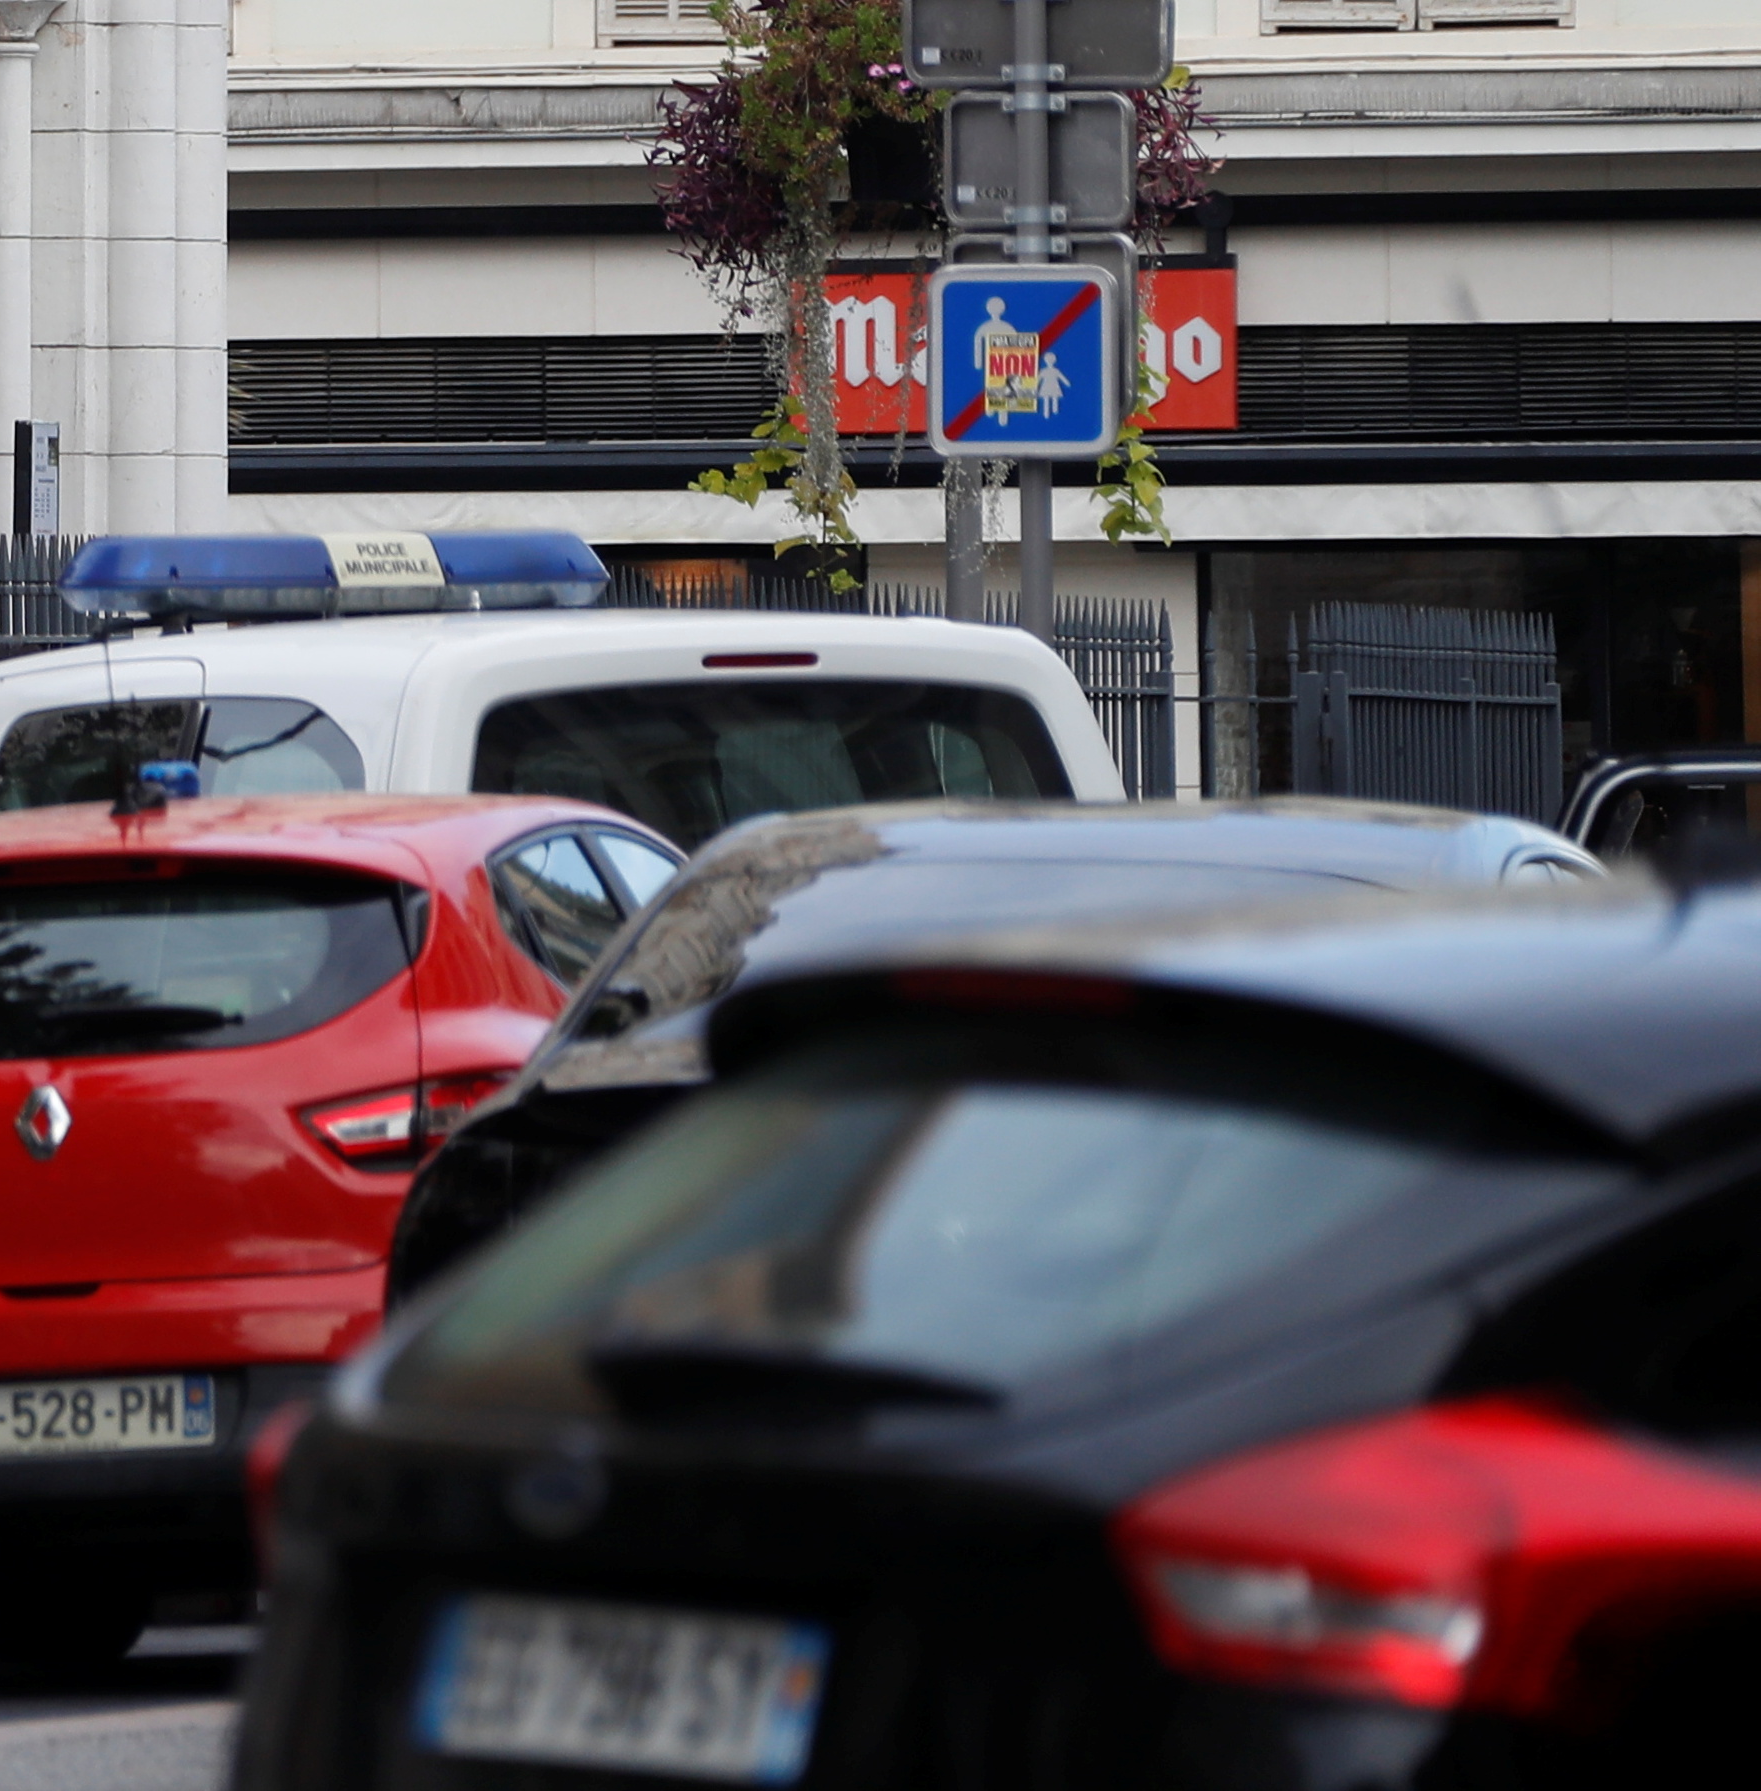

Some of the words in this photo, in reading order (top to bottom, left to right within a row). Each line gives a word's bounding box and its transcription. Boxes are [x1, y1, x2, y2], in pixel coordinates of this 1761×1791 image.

[989, 353, 1036, 378] NON
[355, 542, 407, 557] POLICE
[344, 559, 430, 575] MUNICIPALE
